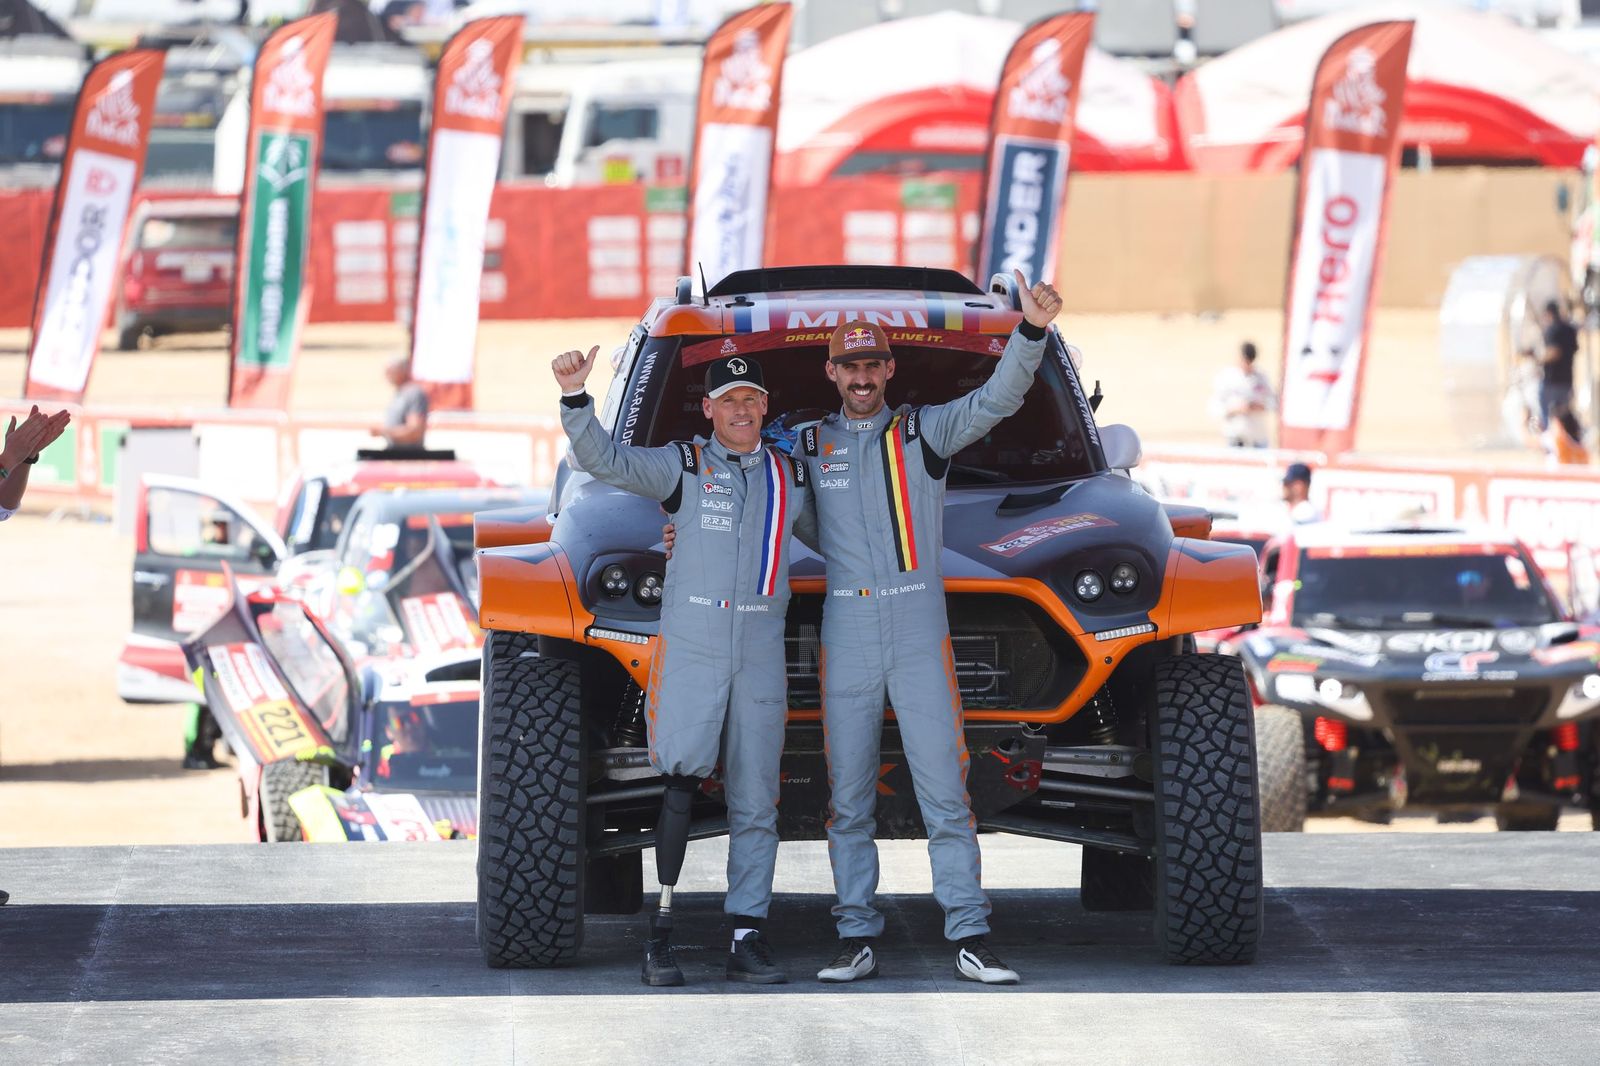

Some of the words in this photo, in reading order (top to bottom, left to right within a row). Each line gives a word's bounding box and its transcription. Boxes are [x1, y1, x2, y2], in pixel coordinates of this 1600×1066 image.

[1312, 194, 1359, 323] Hero
[786, 310, 929, 330] MINI
[844, 339, 861, 350] Red
[859, 336, 877, 347] Bull
[891, 331, 925, 342] LIVE
[880, 588, 889, 597] G.
[889, 587, 899, 596] DE
[899, 582, 926, 593] MEVIUS
[259, 706, 306, 749] 221
